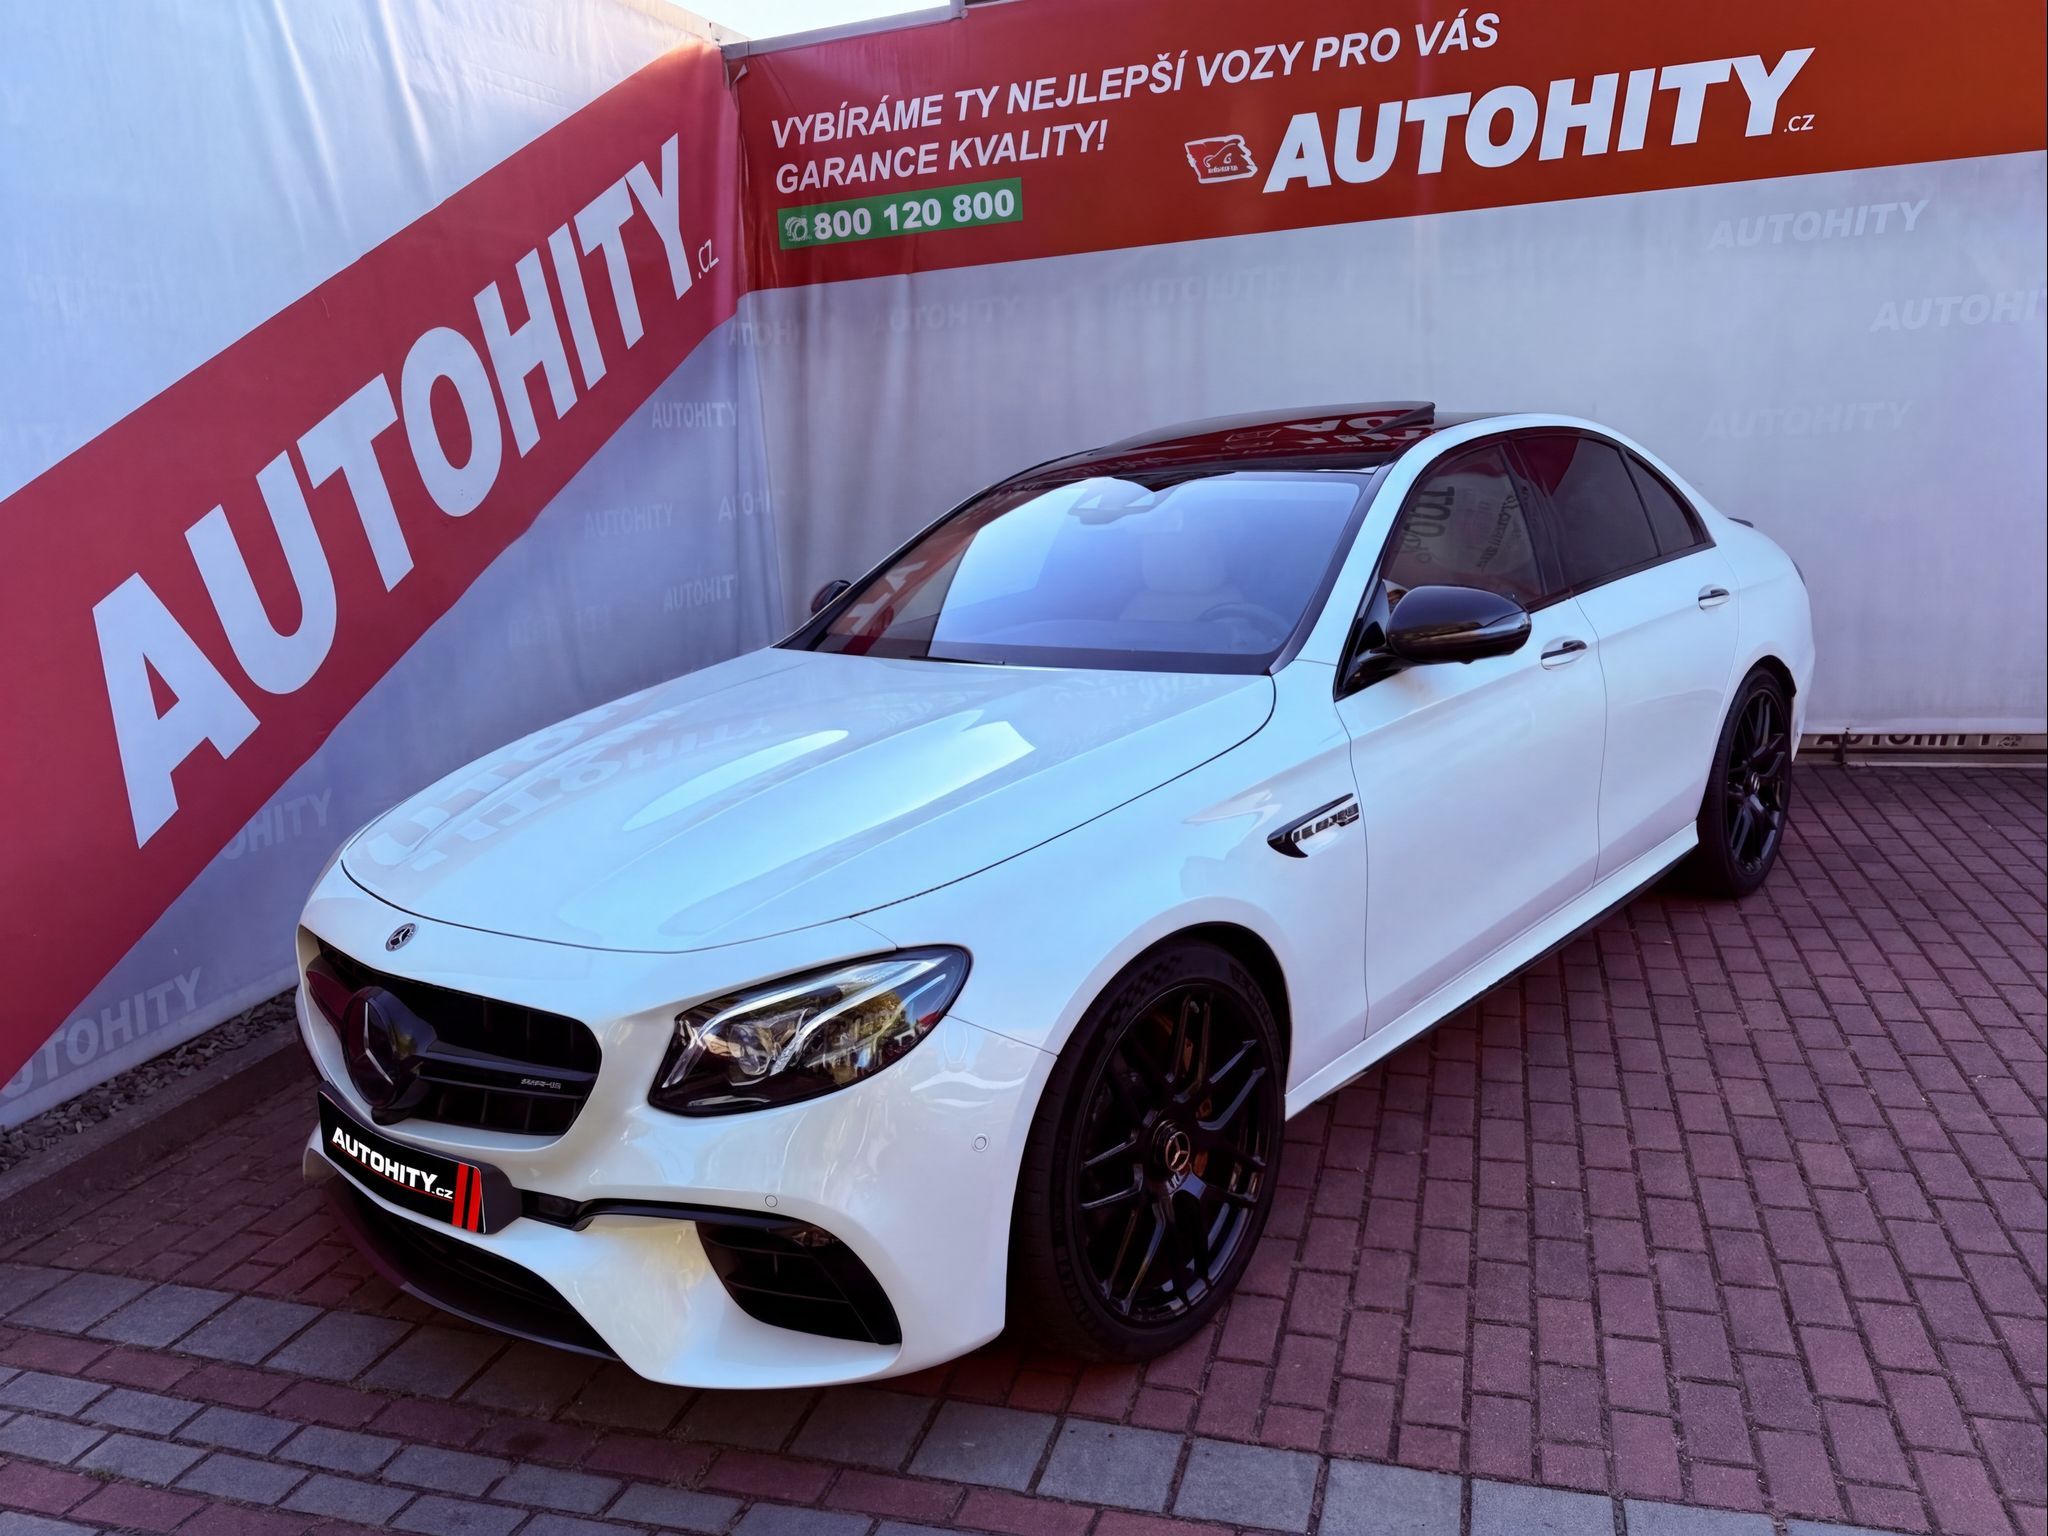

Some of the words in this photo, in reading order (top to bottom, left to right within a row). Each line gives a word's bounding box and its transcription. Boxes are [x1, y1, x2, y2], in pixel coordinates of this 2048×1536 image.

[772, 94, 943, 149] VYBÍRÁME
[955, 86, 1000, 122] TY
[1007, 50, 1187, 115] NEJLEPŠÍ
[1197, 41, 1304, 87] VOZY
[1312, 27, 1400, 72] PRO
[1415, 8, 1500, 57] VÁS
[775, 143, 939, 194] GARANCE
[948, 119, 1109, 170] KVALITY!
[814, 208, 872, 241] 800
[883, 198, 942, 231] 120
[952, 189, 1015, 222] 800
[1706, 199, 1929, 251] AUTOHITY
